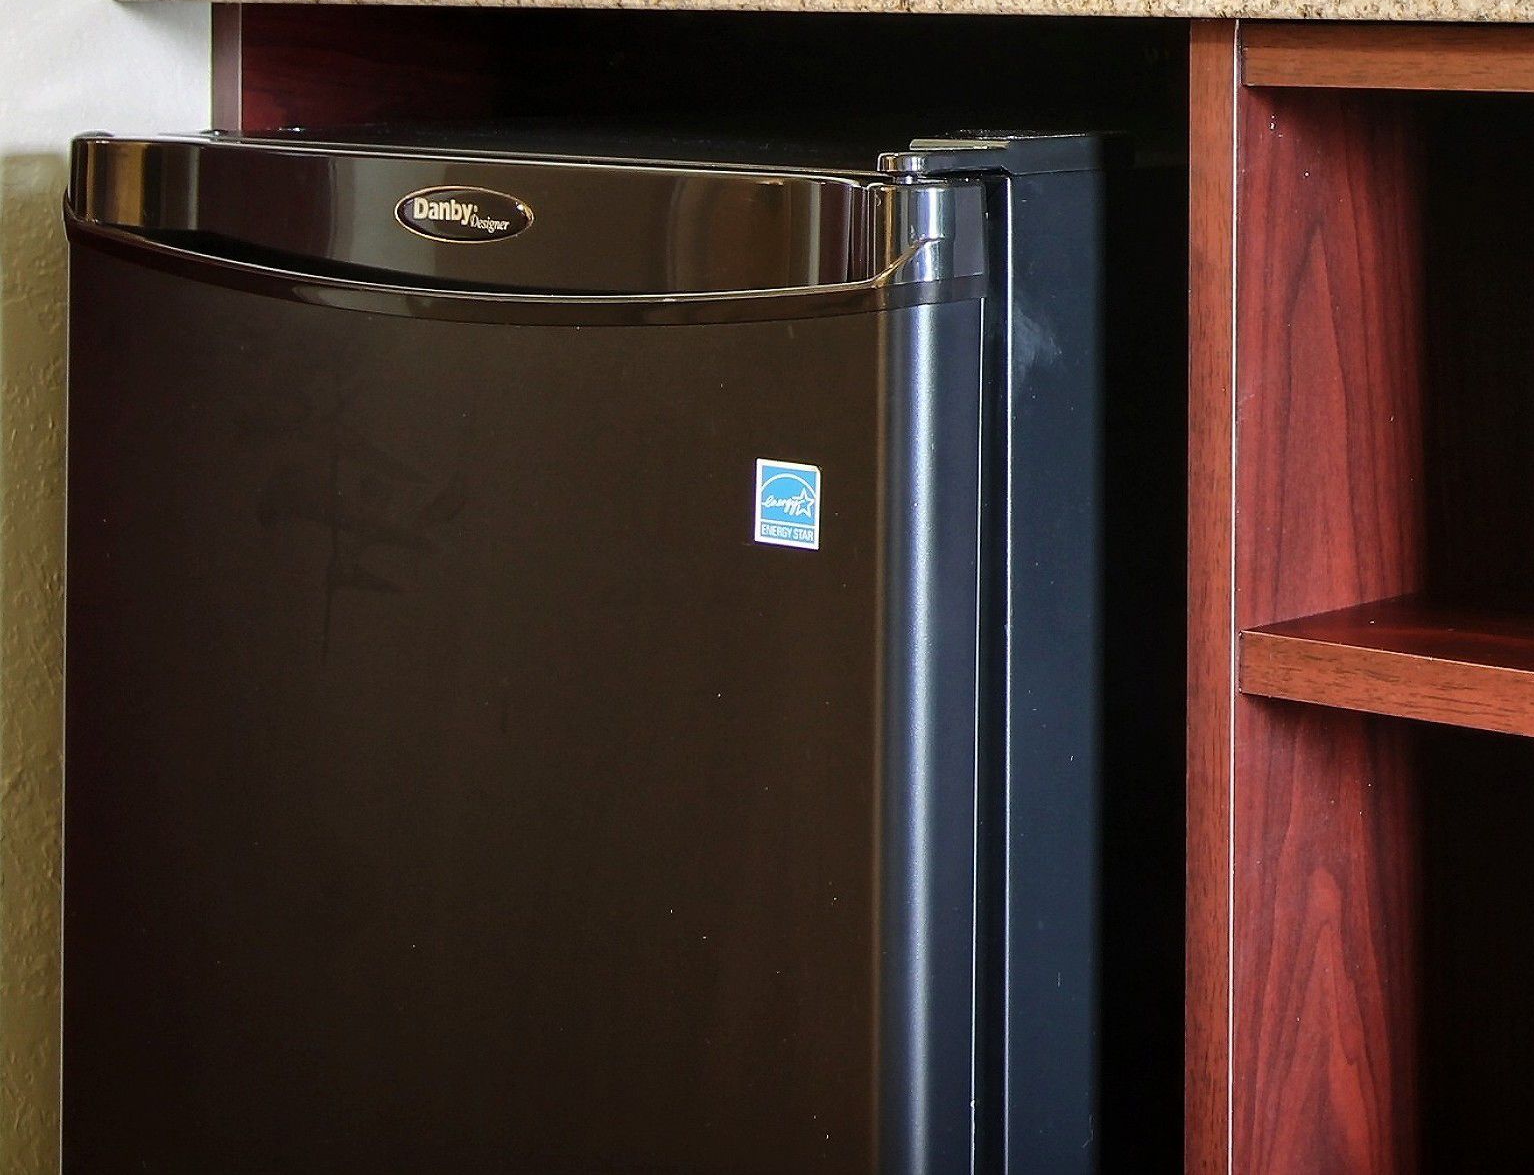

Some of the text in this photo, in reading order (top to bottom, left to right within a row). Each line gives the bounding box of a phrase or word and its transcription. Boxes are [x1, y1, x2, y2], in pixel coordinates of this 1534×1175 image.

[413, 197, 478, 226] Danby
[470, 213, 510, 234] Designer
[761, 524, 815, 541] ENERGY STAR
